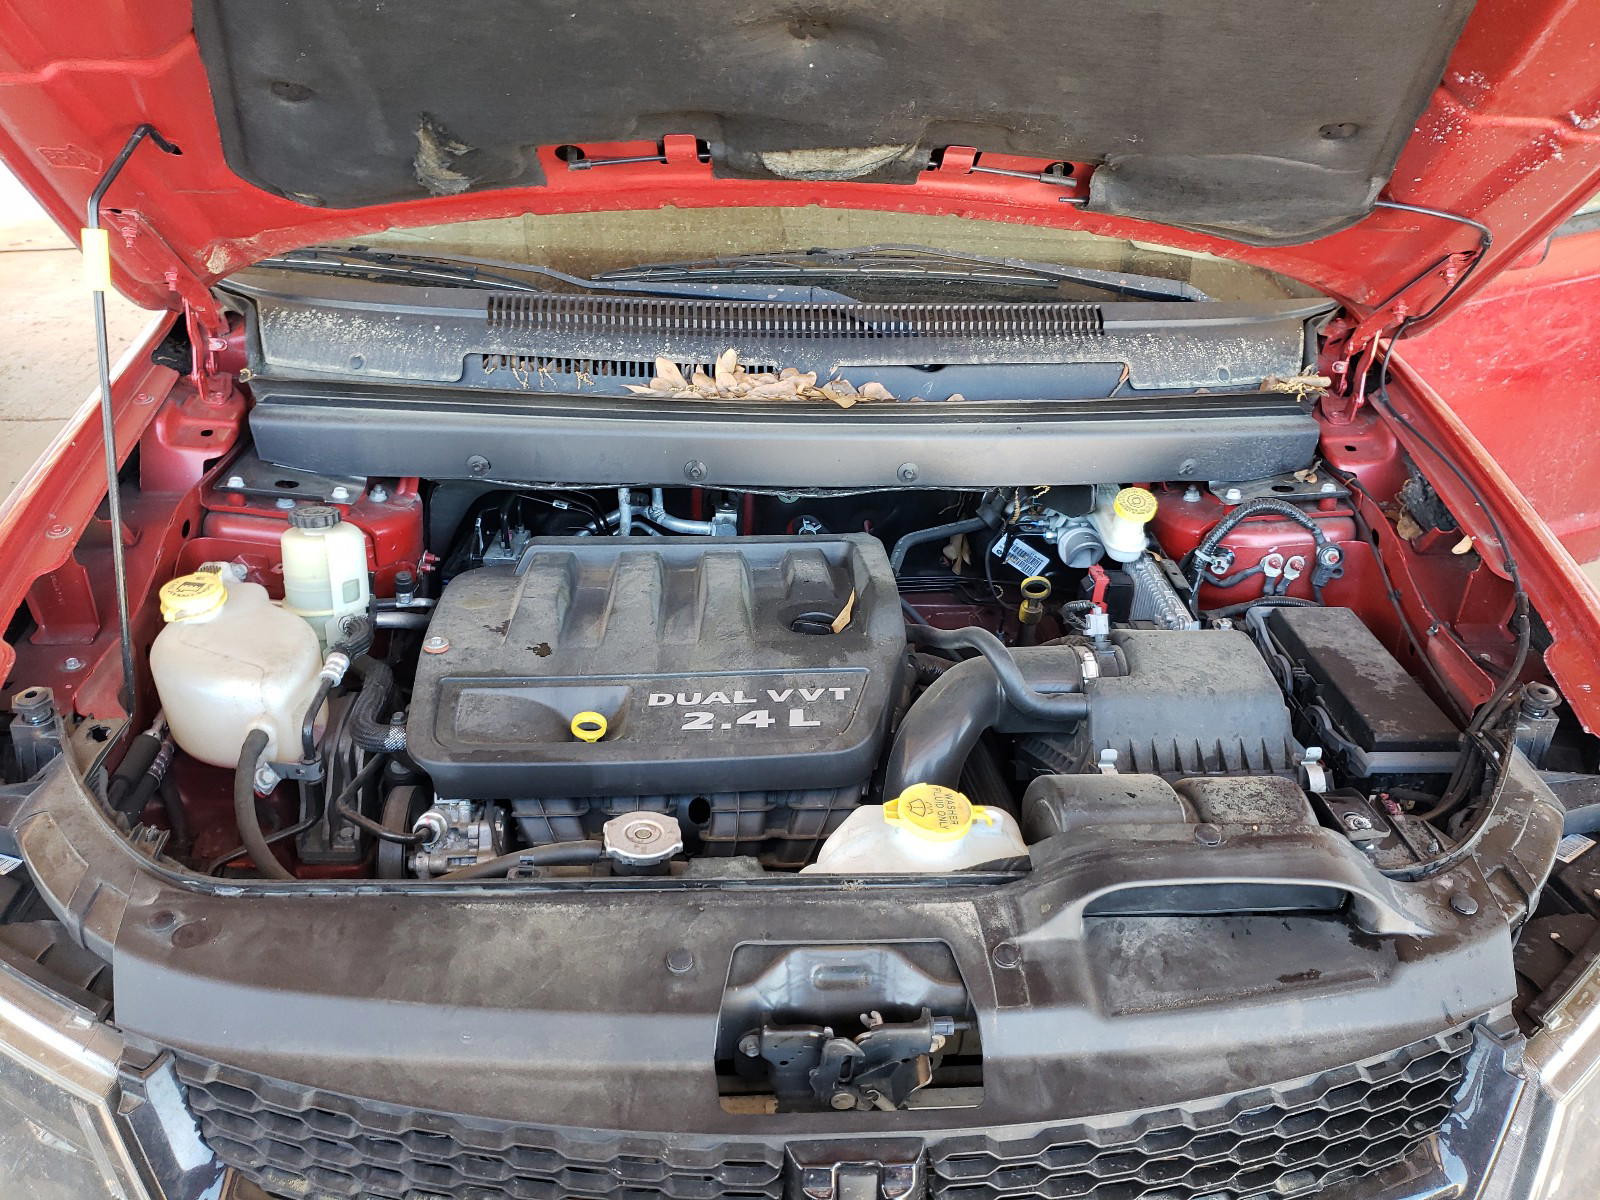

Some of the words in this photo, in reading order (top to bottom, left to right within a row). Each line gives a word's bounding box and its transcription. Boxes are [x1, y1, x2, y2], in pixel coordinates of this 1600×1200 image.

[648, 690, 757, 706] DUAL
[767, 687, 851, 702] VVT
[681, 709, 776, 731] 2.4
[788, 708, 821, 727] L
[932, 787, 944, 808] FLUID
[938, 810, 949, 829] ONLY
[945, 793, 959, 824] WASHER
